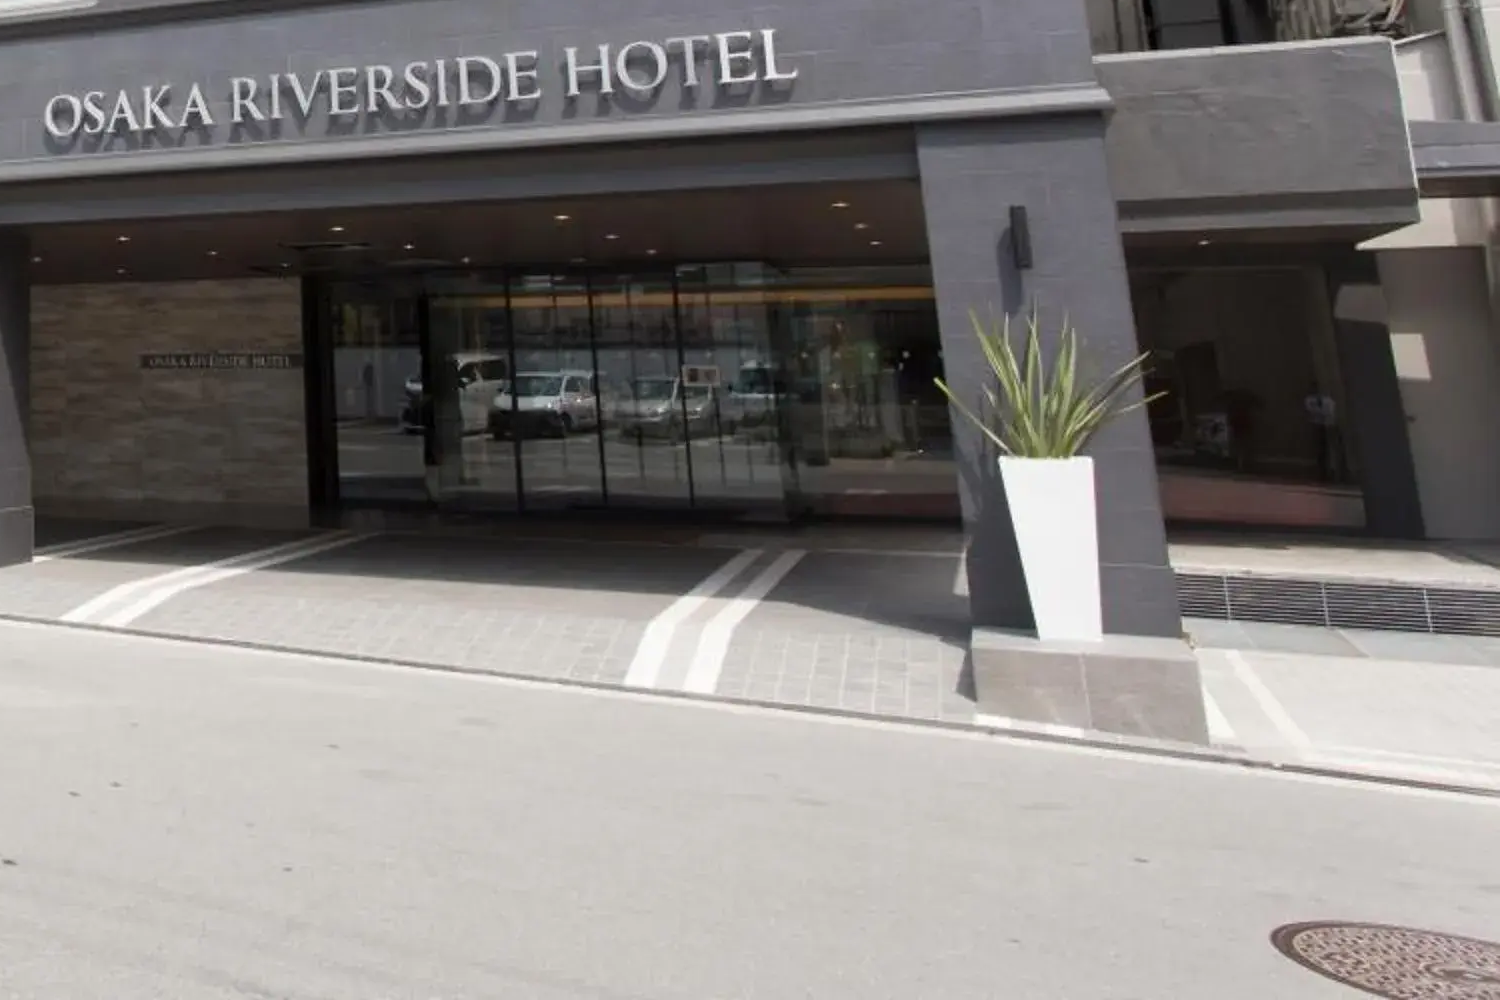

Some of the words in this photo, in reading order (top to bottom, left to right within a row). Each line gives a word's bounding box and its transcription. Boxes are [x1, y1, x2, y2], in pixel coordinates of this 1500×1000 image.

[44, 82, 216, 137] OSAKA
[229, 50, 542, 124] RIVERSIDE
[563, 28, 799, 98] HOTEL
